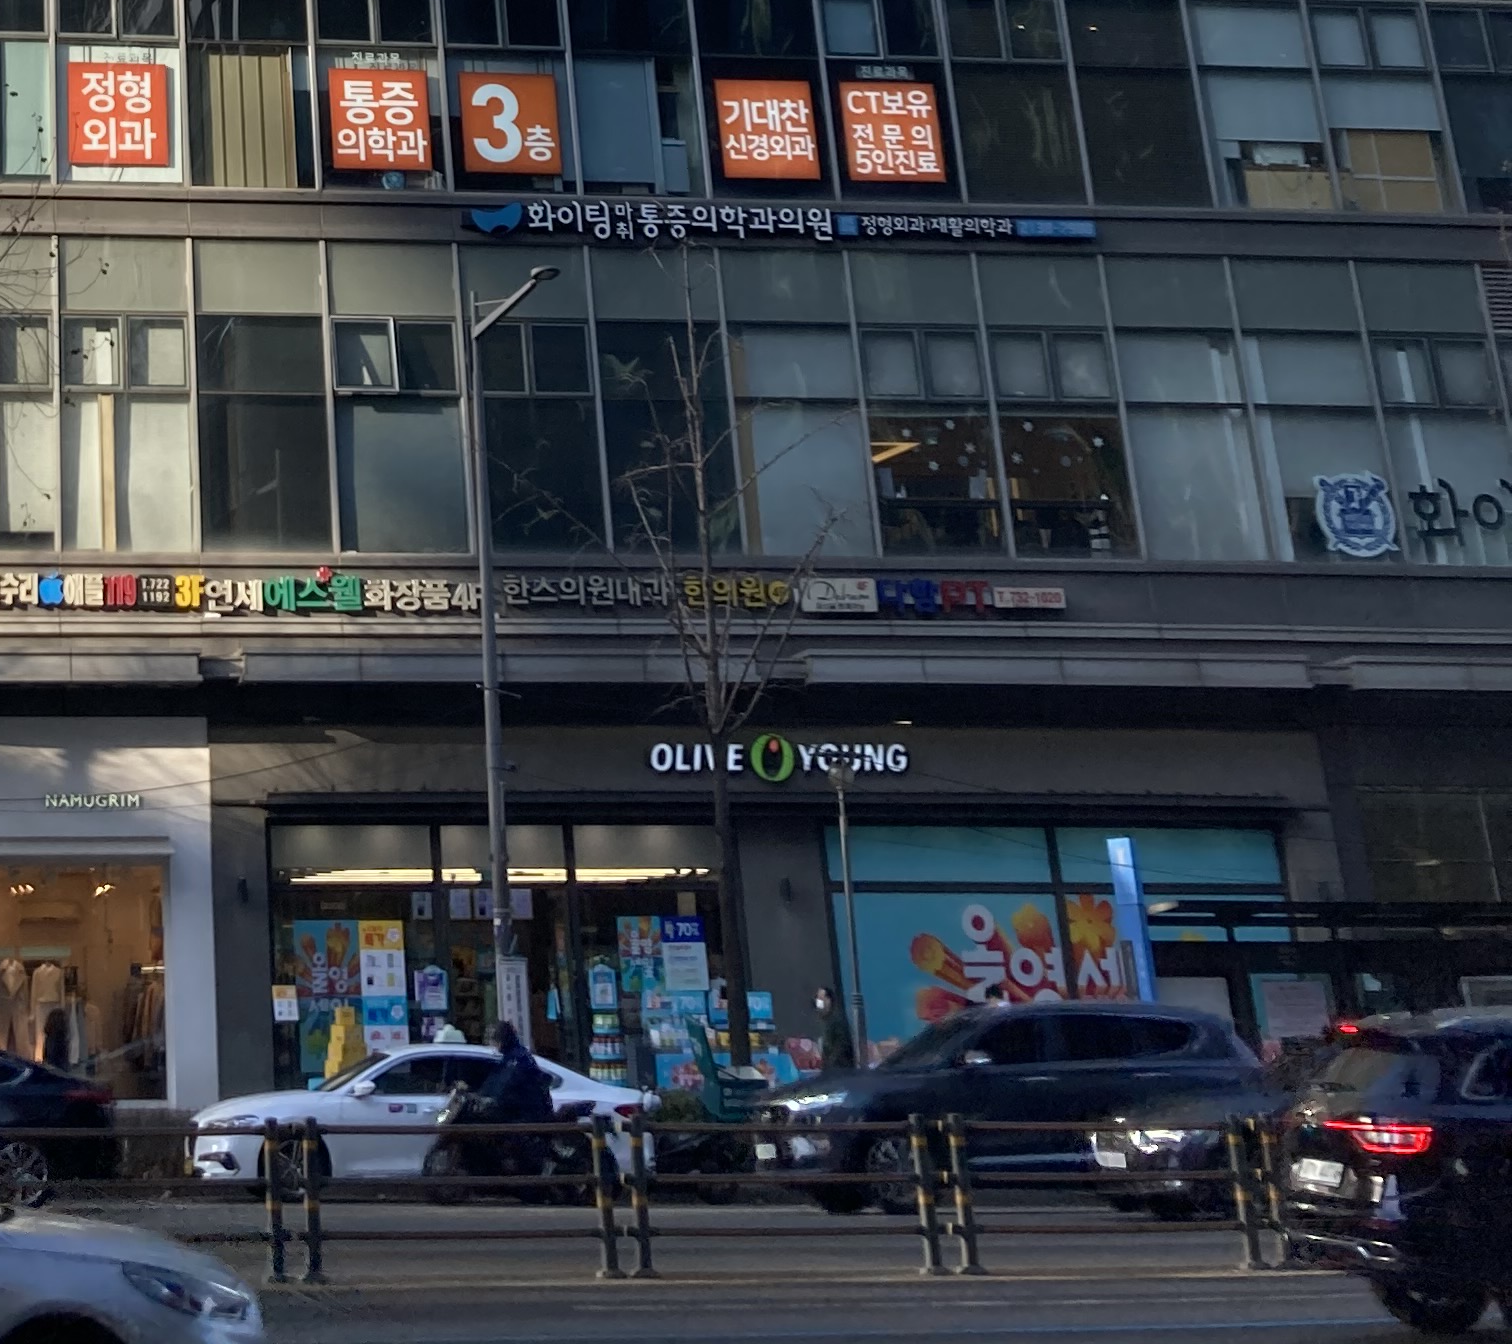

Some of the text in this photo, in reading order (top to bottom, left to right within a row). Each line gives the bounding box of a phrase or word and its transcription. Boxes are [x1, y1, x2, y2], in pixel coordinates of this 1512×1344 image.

[81, 69, 152, 114] 정형
[339, 79, 420, 126] 통증
[846, 89, 931, 118] CT보유
[470, 83, 556, 164] 3층
[723, 98, 810, 134] 기대찬
[82, 117, 157, 161] 외과
[337, 127, 428, 164] 의학과
[725, 134, 816, 163] 신경외과
[855, 149, 942, 177] 5인진료
[636, 205, 835, 243] 통증의학과의원
[861, 214, 927, 237] 정형외과
[931, 216, 1014, 238] 재활의학과
[63, 572, 104, 607] 애플
[104, 574, 137, 607] 119
[364, 578, 451, 612] 화장품
[797, 743, 909, 773] YOUNG
[44, 792, 141, 809] NAMUGRIM
